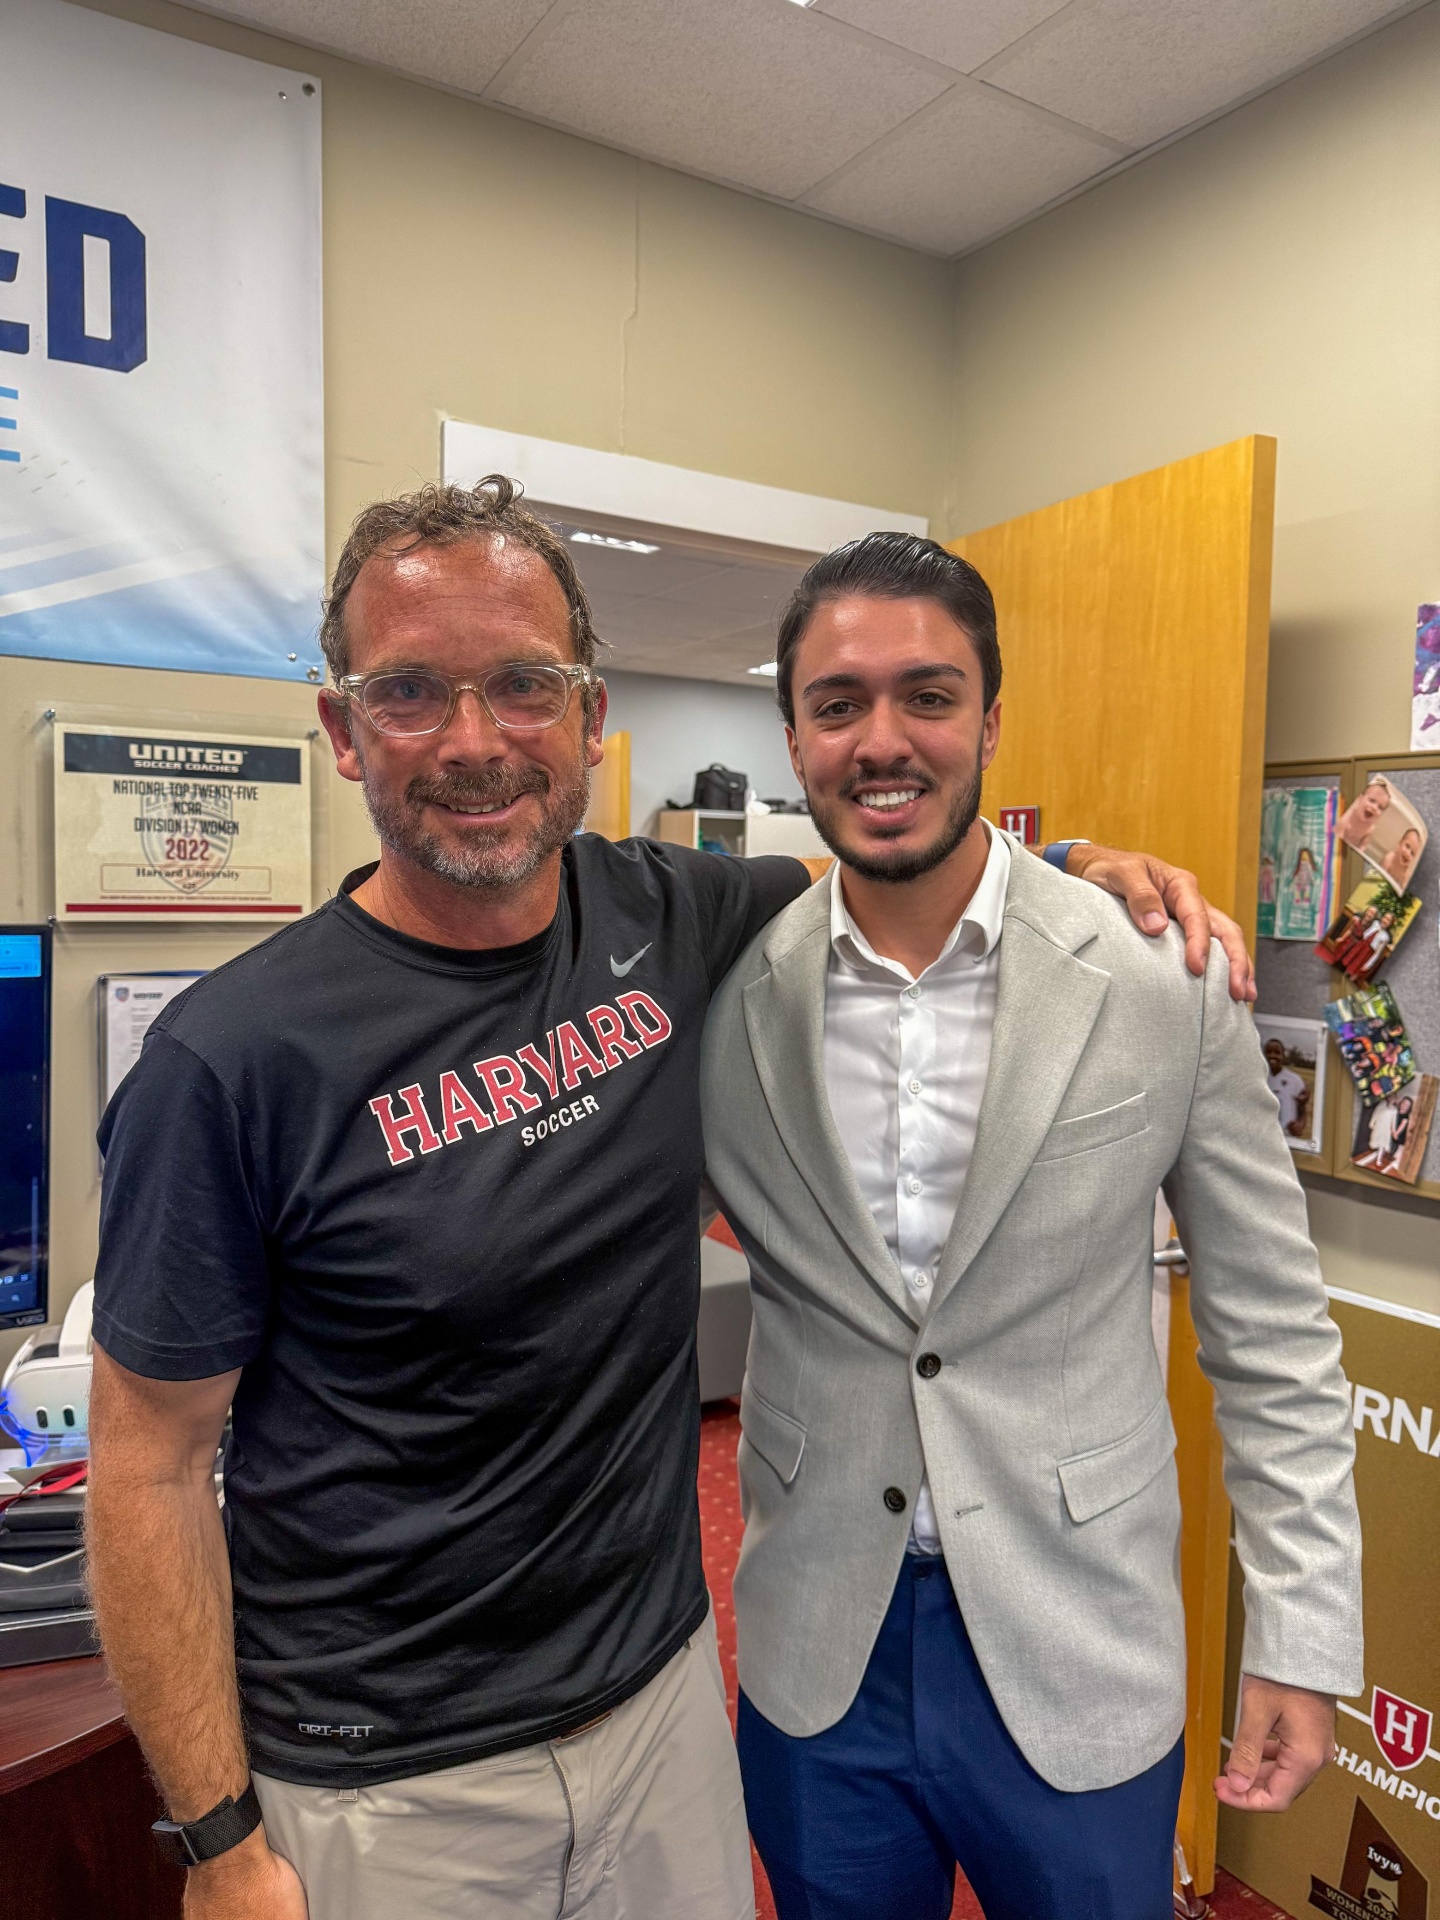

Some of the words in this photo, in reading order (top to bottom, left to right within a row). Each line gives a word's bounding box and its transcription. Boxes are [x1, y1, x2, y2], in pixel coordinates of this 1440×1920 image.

[128, 743, 243, 765] UNITED
[134, 760, 182, 770] SOCCER
[184, 762, 239, 773] COACHES
[113, 780, 166, 796] NATIONAL
[169, 781, 189, 797] TOP
[193, 782, 259, 800] TWENTY-FIVE
[173, 801, 202, 815] NCAA
[134, 818, 181, 833] DIVISION
[200, 820, 239, 835] WOMEN
[1006, 813, 1027, 845] H
[165, 838, 210, 861] 2022
[136, 867, 183, 877] Harvard
[186, 868, 240, 881] University
[369, 990, 672, 1166] HARVARD
[521, 1094, 600, 1147] SOCCER
[1347, 1381, 1440, 1458] RN
[298, 1723, 374, 1738] DRI-FIT
[1382, 1701, 1417, 1755] H
